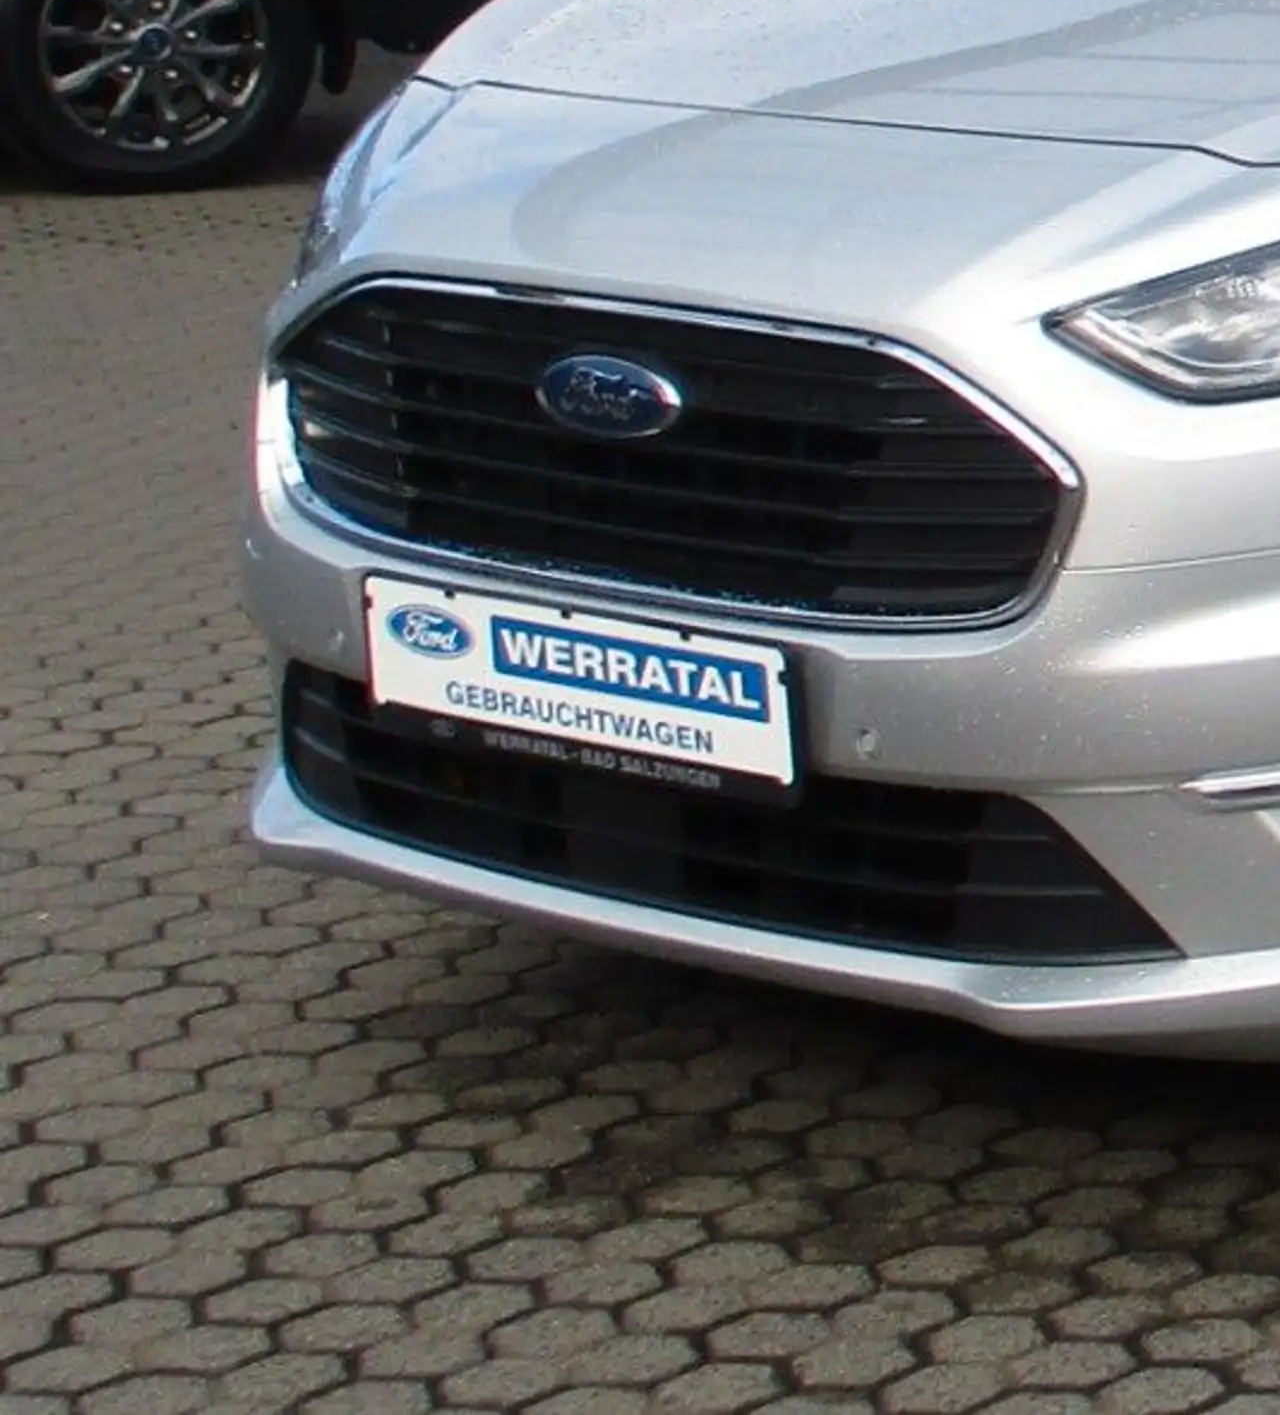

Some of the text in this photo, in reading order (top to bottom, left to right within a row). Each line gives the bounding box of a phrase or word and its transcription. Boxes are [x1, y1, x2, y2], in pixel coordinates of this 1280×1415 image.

[403, 611, 459, 651] Ford
[500, 629, 760, 709] WERRATAL
[446, 682, 714, 753] GEBRAUCHTWAGEN
